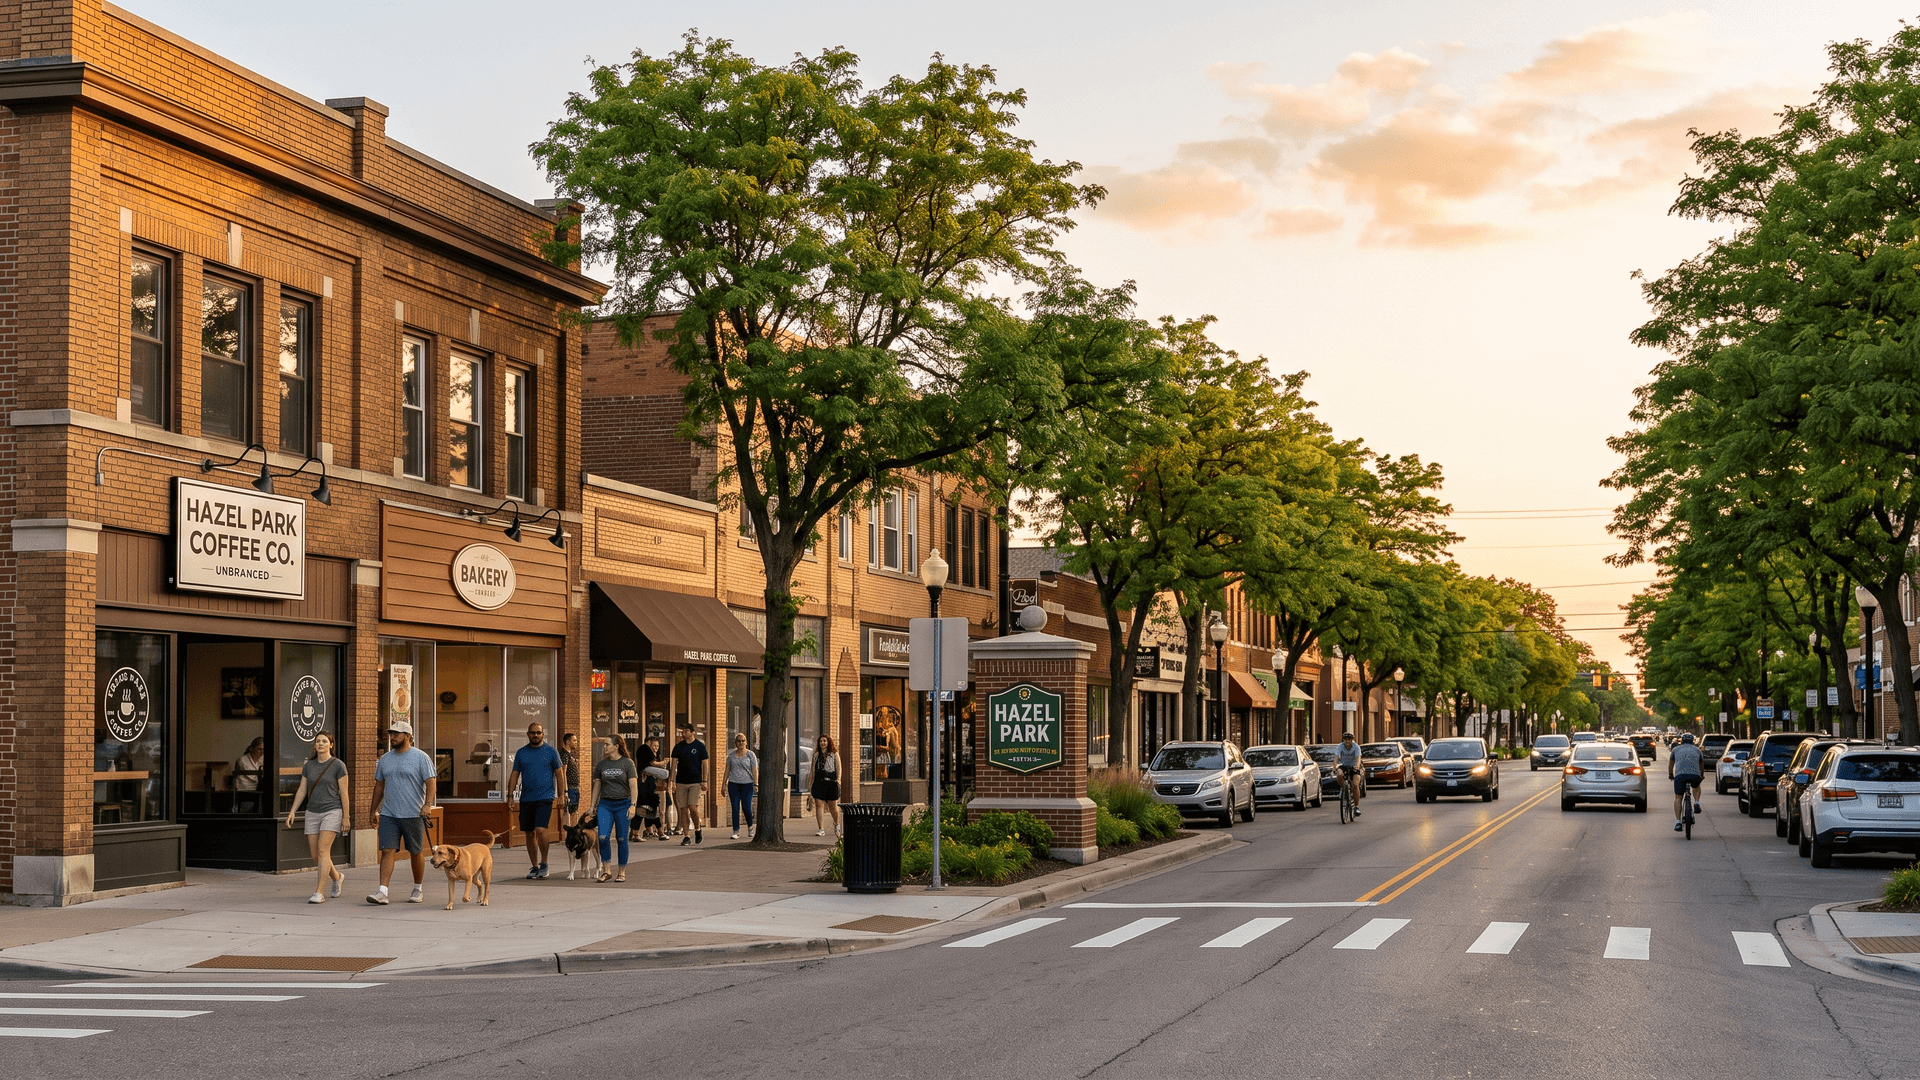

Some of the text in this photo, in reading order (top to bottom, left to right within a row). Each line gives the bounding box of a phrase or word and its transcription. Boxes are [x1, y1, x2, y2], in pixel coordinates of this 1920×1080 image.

[187, 498, 297, 537] HAZEL PARK
[190, 530, 294, 566] COFFEE CO.
[215, 565, 269, 580] UNBRANCED
[461, 564, 508, 587] BAKERY
[995, 703, 1055, 721] HAZEL
[1000, 724, 1050, 742] PARK
